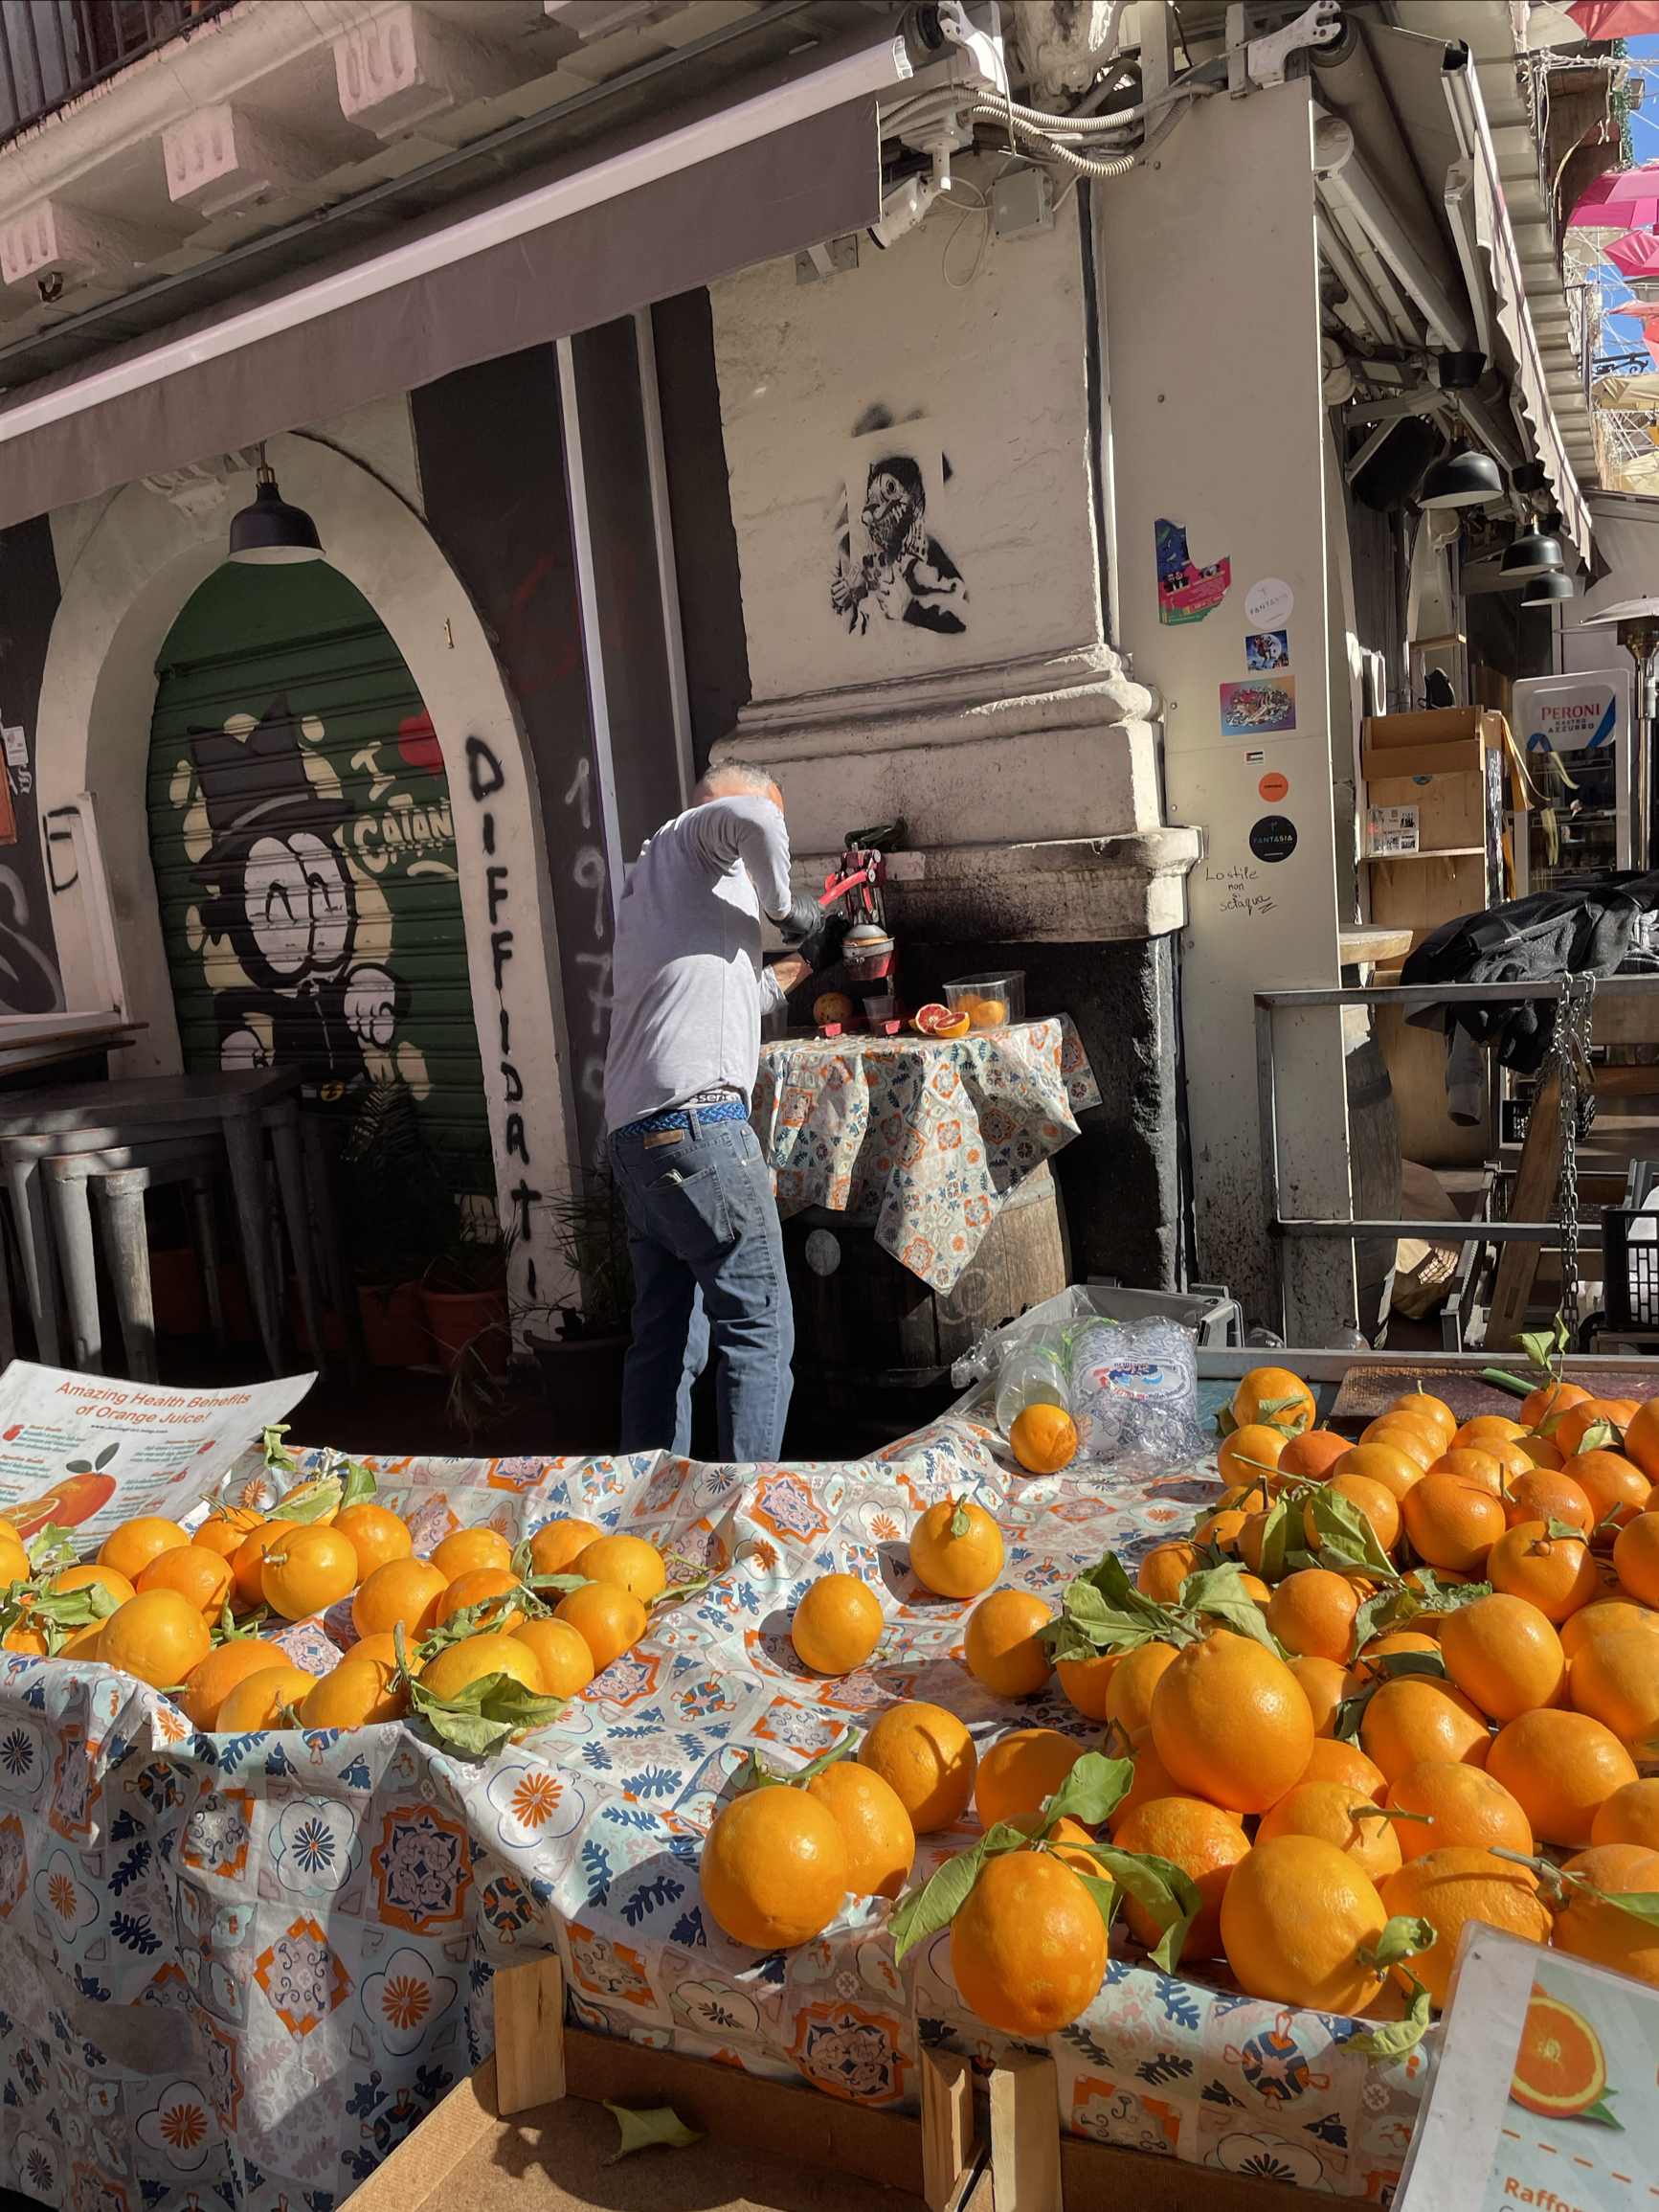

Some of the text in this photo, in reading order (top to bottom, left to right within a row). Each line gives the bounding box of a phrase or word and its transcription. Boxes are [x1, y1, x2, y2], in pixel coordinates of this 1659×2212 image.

[1249, 592, 1289, 616] FANTASIA
[1541, 704, 1600, 720] PERONI
[1548, 723, 1594, 734] AZZURRO
[1253, 834, 1293, 844] FANTASIA
[56, 1381, 253, 1409] Amazing Health Benefits
[75, 1404, 212, 1425] of Orange Juice!
[1504, 2176, 1590, 2212] Raffo
